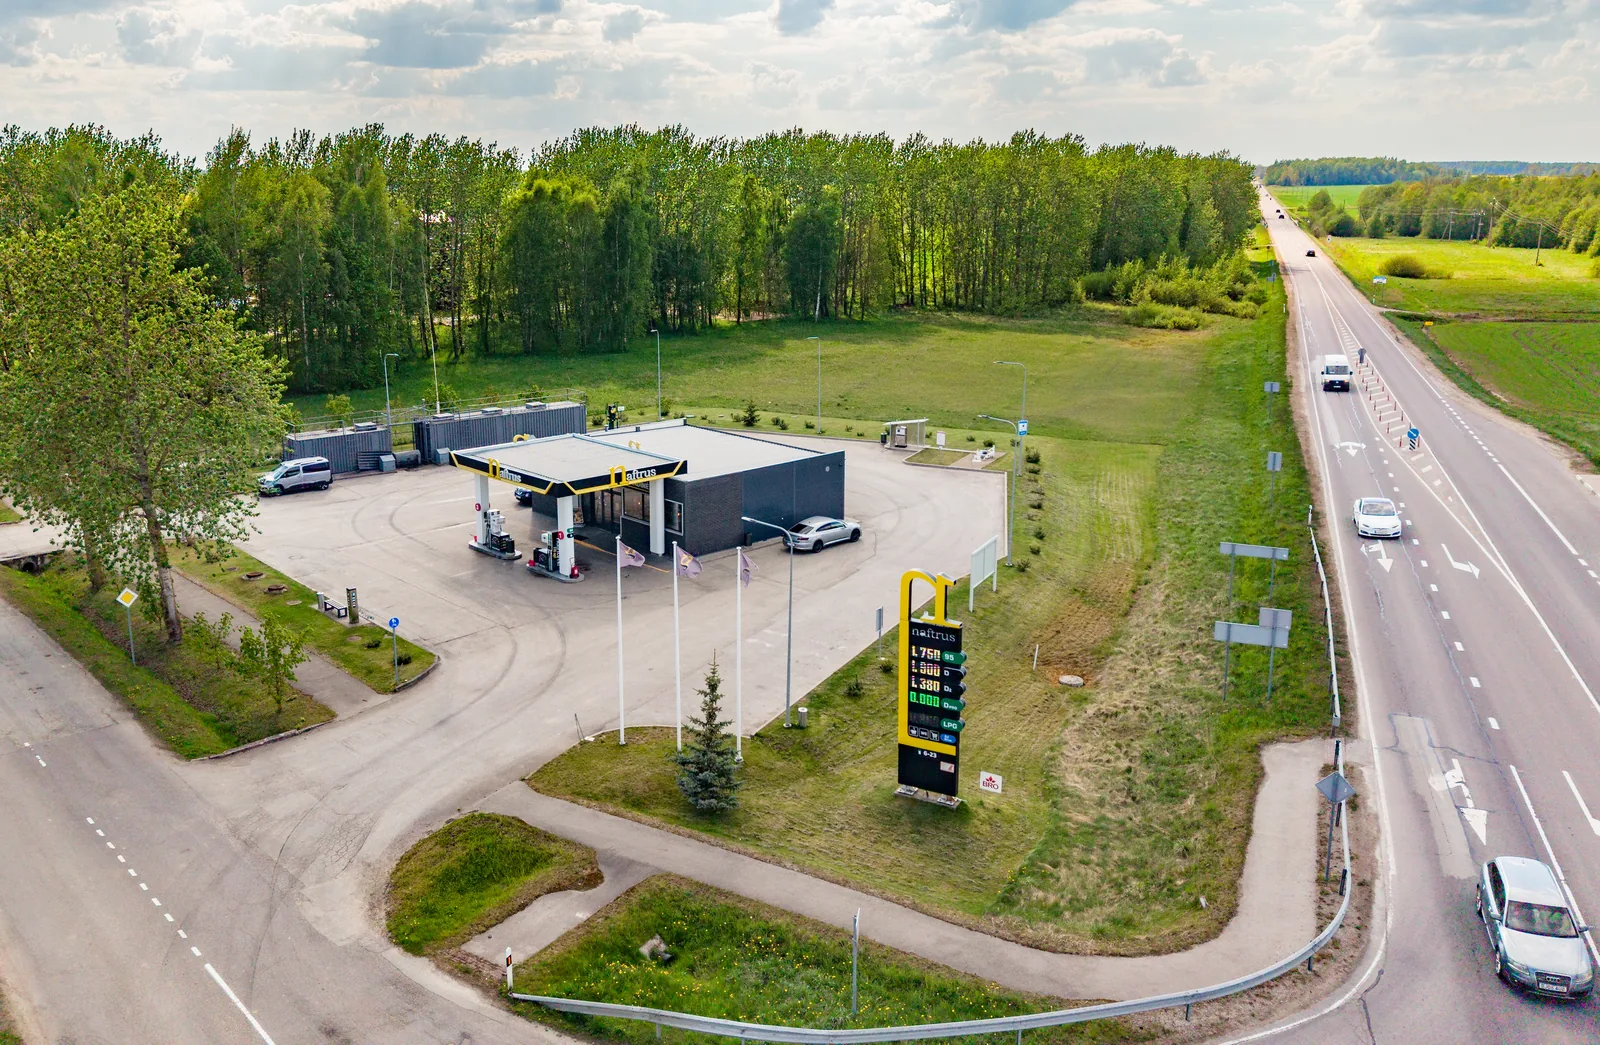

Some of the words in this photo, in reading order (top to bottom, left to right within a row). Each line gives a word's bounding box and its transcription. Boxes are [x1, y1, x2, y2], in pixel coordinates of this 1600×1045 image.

[488, 458, 522, 483] naftrus
[609, 465, 656, 488] naftrus
[912, 628, 956, 642] naftrus
[911, 645, 941, 661] 1.750
[944, 653, 955, 661] 95
[943, 669, 950, 677] D
[911, 676, 941, 692] 1.380
[910, 691, 940, 708] 0.000
[943, 721, 958, 729] LPG
[982, 780, 999, 790] BRO
